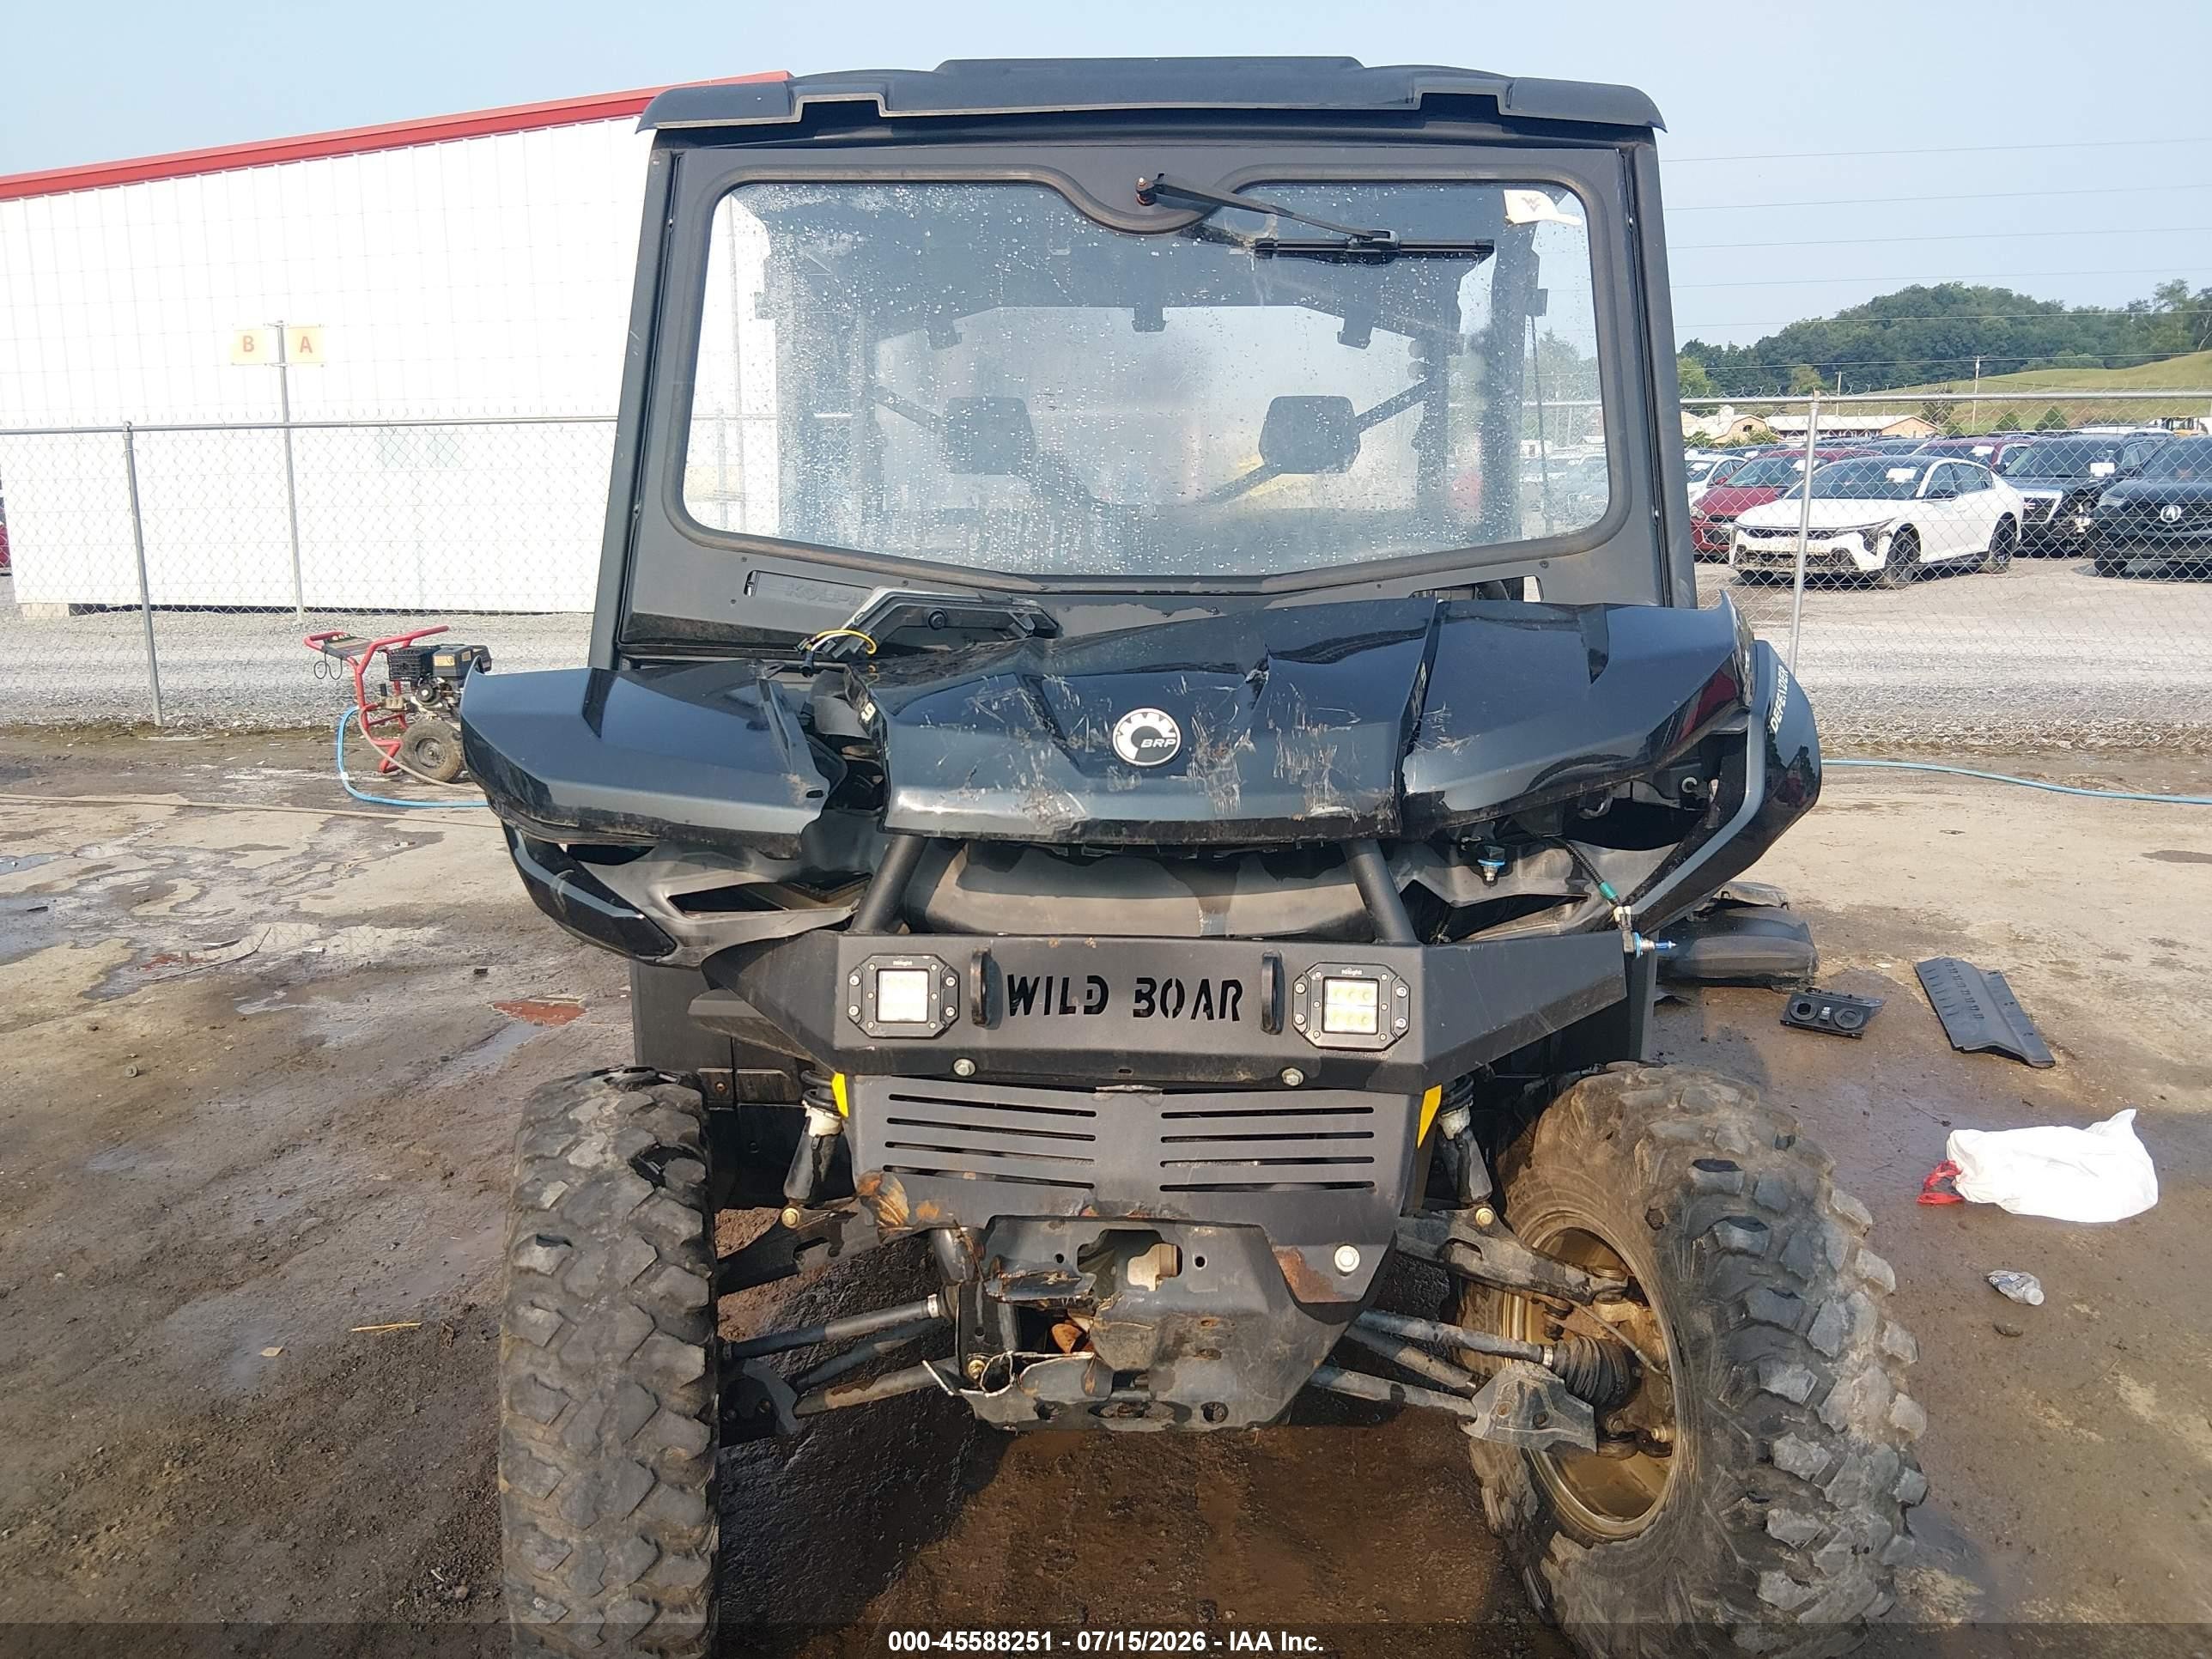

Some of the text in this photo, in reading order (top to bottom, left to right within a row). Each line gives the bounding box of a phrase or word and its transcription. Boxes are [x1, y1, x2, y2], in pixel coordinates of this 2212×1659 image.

[243, 335, 255, 352] B
[299, 336, 313, 354] A
[1770, 665, 1790, 735] DEFENDER
[1140, 738, 1176, 748] BRP
[1007, 974, 1243, 1021] WILD BOAR
